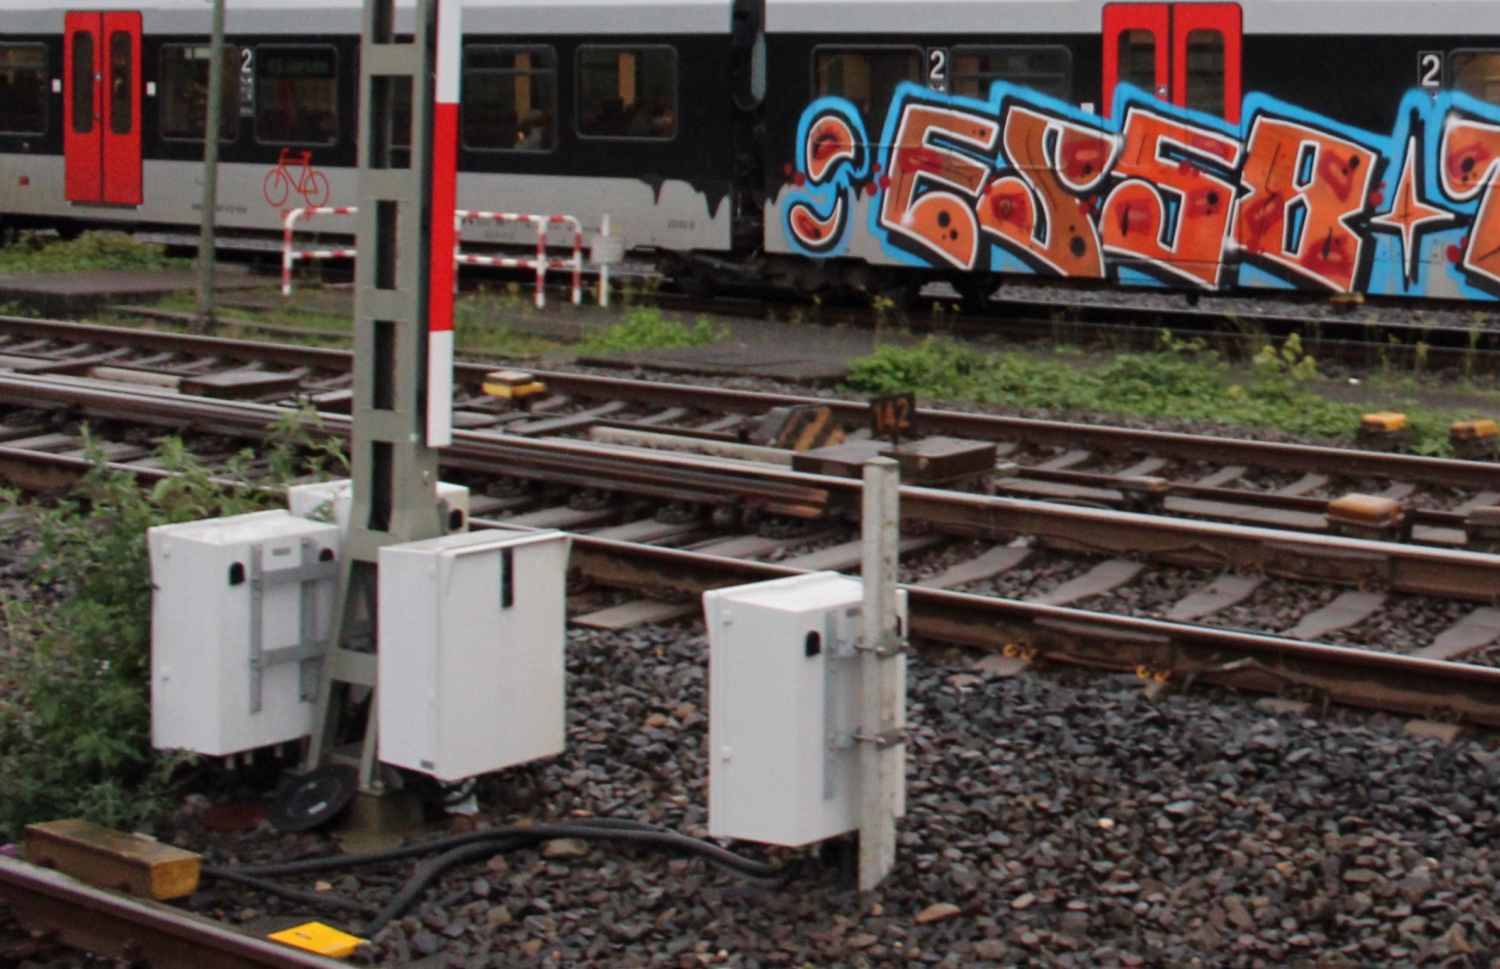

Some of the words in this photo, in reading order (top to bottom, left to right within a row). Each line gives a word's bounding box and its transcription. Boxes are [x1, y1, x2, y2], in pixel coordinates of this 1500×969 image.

[241, 48, 252, 73] 2
[929, 50, 945, 79] 2
[1421, 54, 1441, 87] 2
[872, 396, 910, 431] 142
